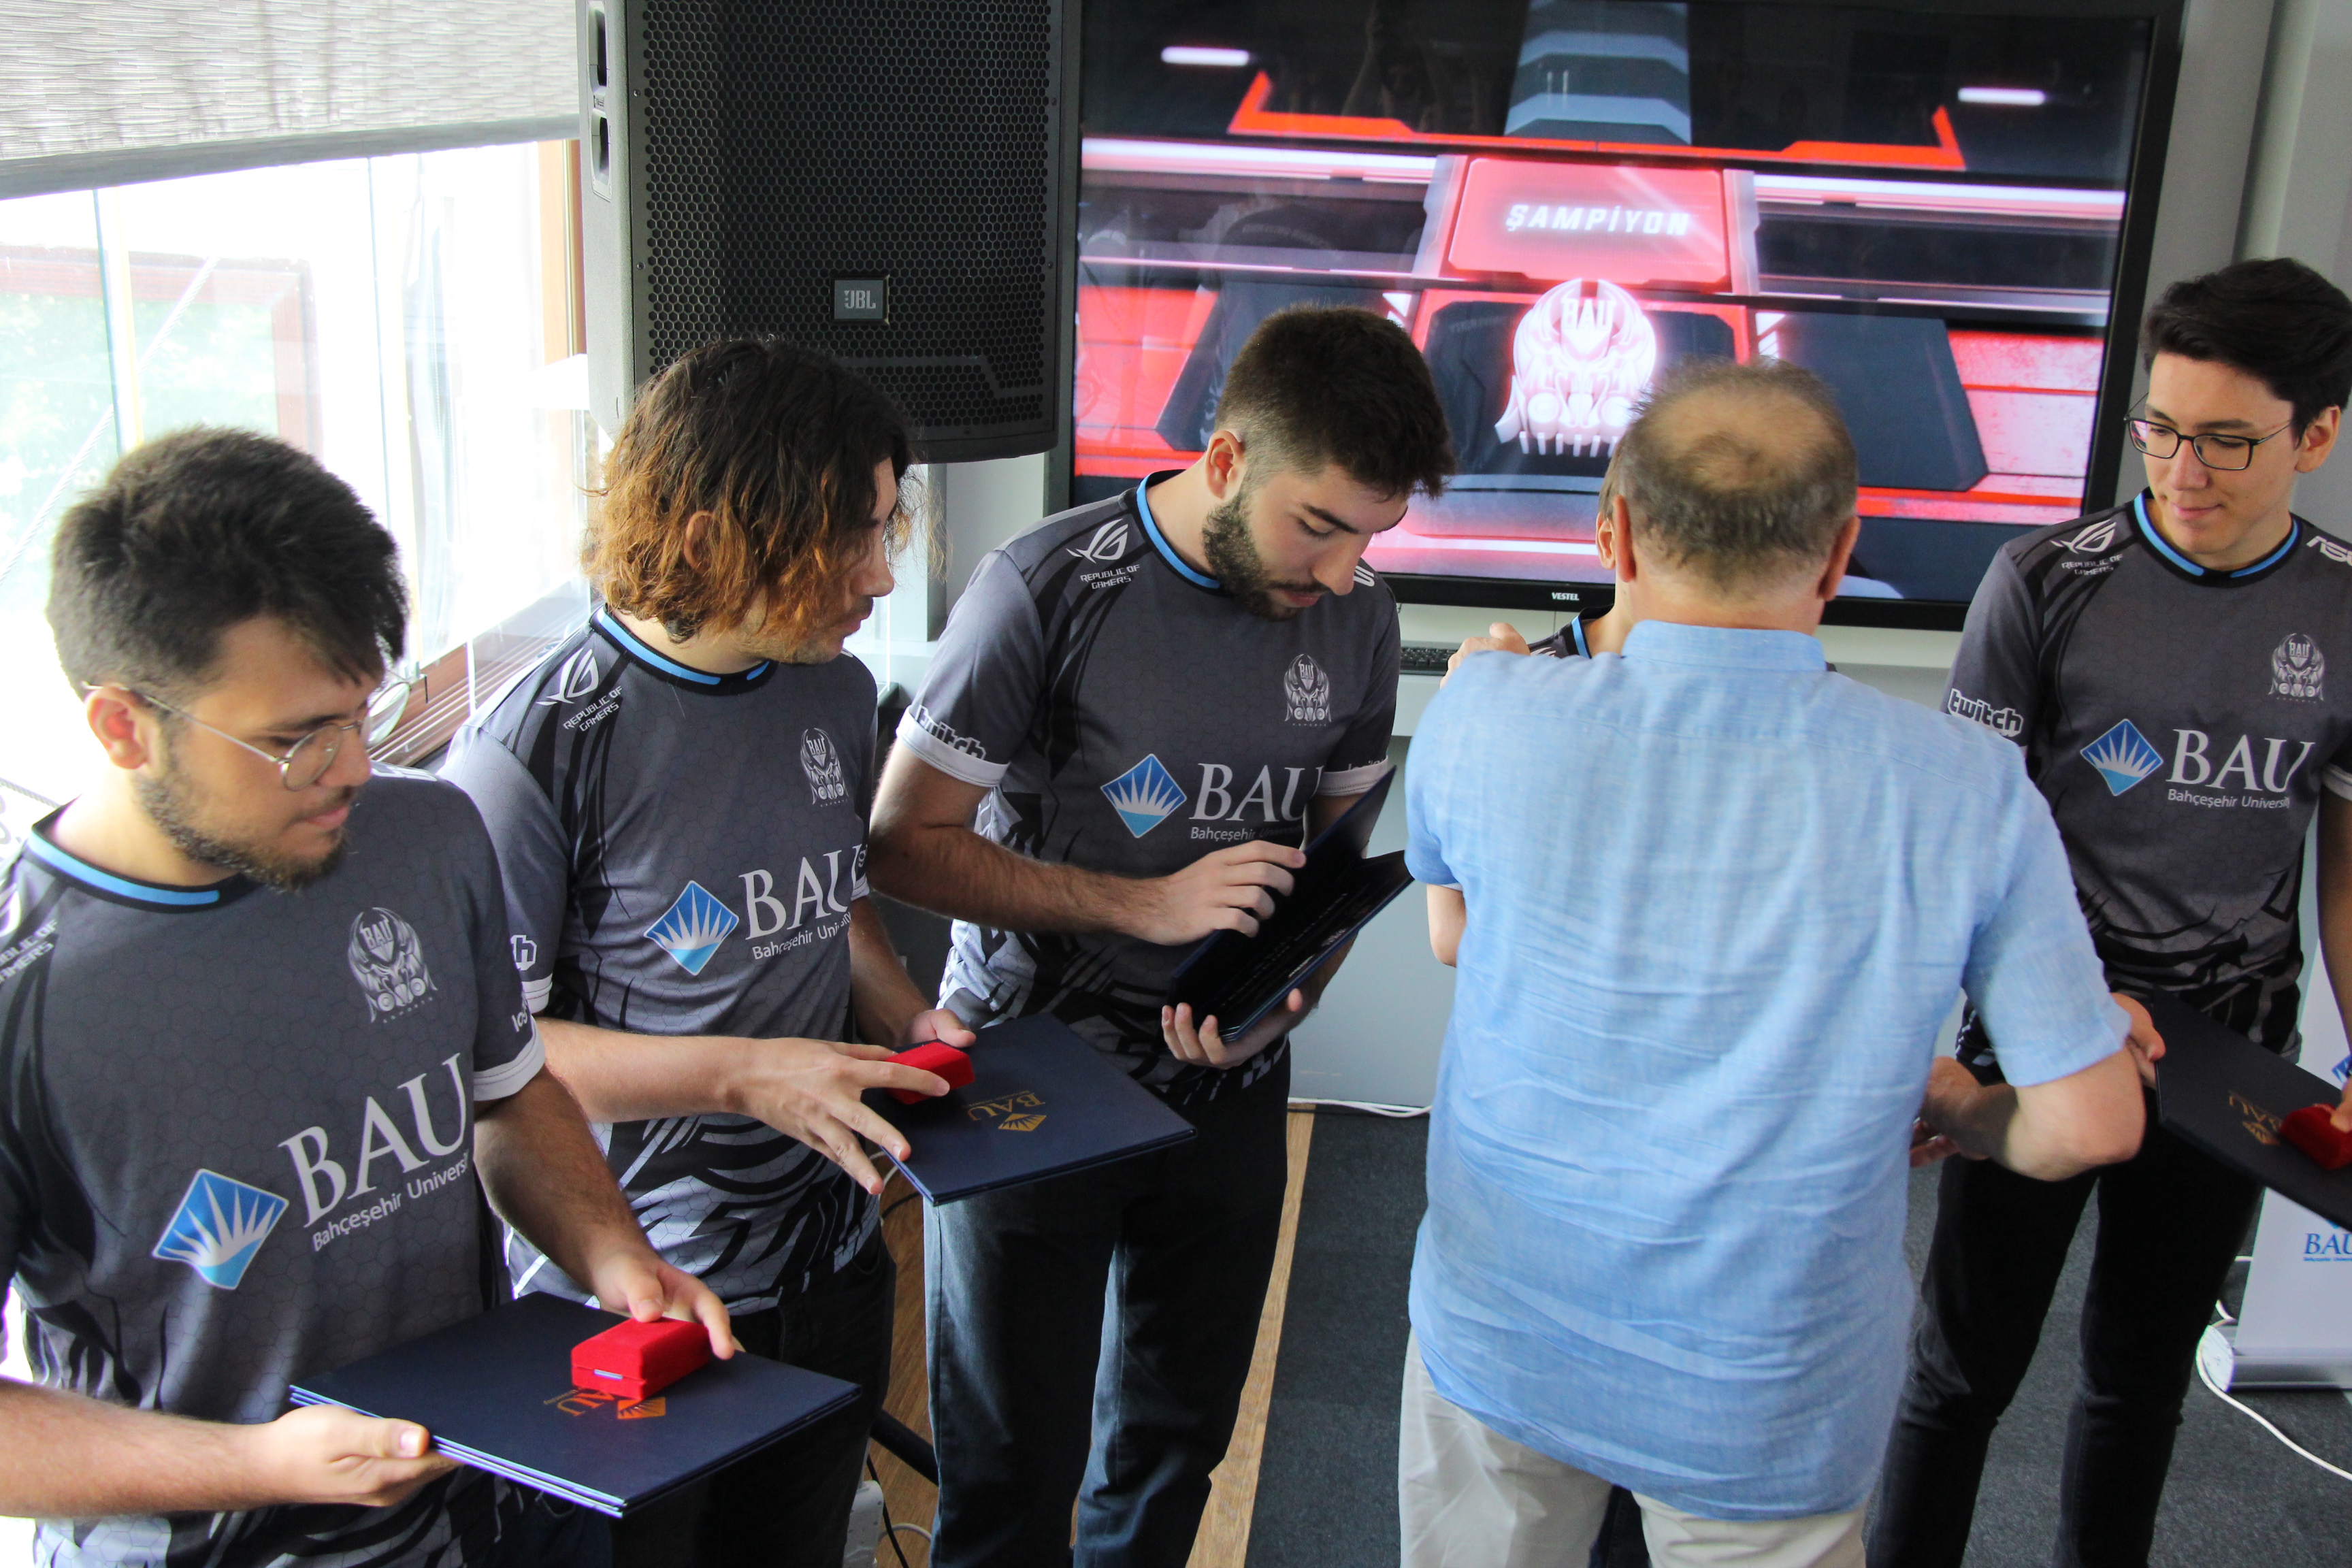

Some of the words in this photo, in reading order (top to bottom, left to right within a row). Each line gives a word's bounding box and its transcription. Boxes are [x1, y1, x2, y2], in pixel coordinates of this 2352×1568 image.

[1505, 204, 1690, 235] ŞAMPİYON
[844, 290, 876, 308] JBL
[1561, 297, 1616, 329] BAU
[2109, 554, 2123, 562] OF
[1080, 568, 1126, 583] REPUBLIC
[1126, 564, 1140, 573] OF
[1091, 576, 1131, 589] GAMERS
[1552, 592, 1580, 601] VESTEL
[2289, 640, 2310, 657] BAU
[1298, 661, 1314, 679] BAU
[563, 696, 610, 730] REPUBLIC
[608, 685, 623, 698] OF
[579, 702, 619, 732] GAMERS
[1948, 688, 2024, 736] twitch
[806, 735, 826, 755] BAU
[2166, 729, 2315, 793] BAU
[1189, 763, 1324, 821] BAU
[2168, 789, 2238, 808] Bahçeşehir
[1191, 827, 1255, 840] Bahçeşehir
[738, 844, 862, 940] BAU
[35, 919, 58, 937] OF
[361, 915, 393, 950] BAU
[967, 1092, 1045, 1121] BAU
[278, 1053, 466, 1228] BAU
[312, 1193, 402, 1252] Bahçeşehir
